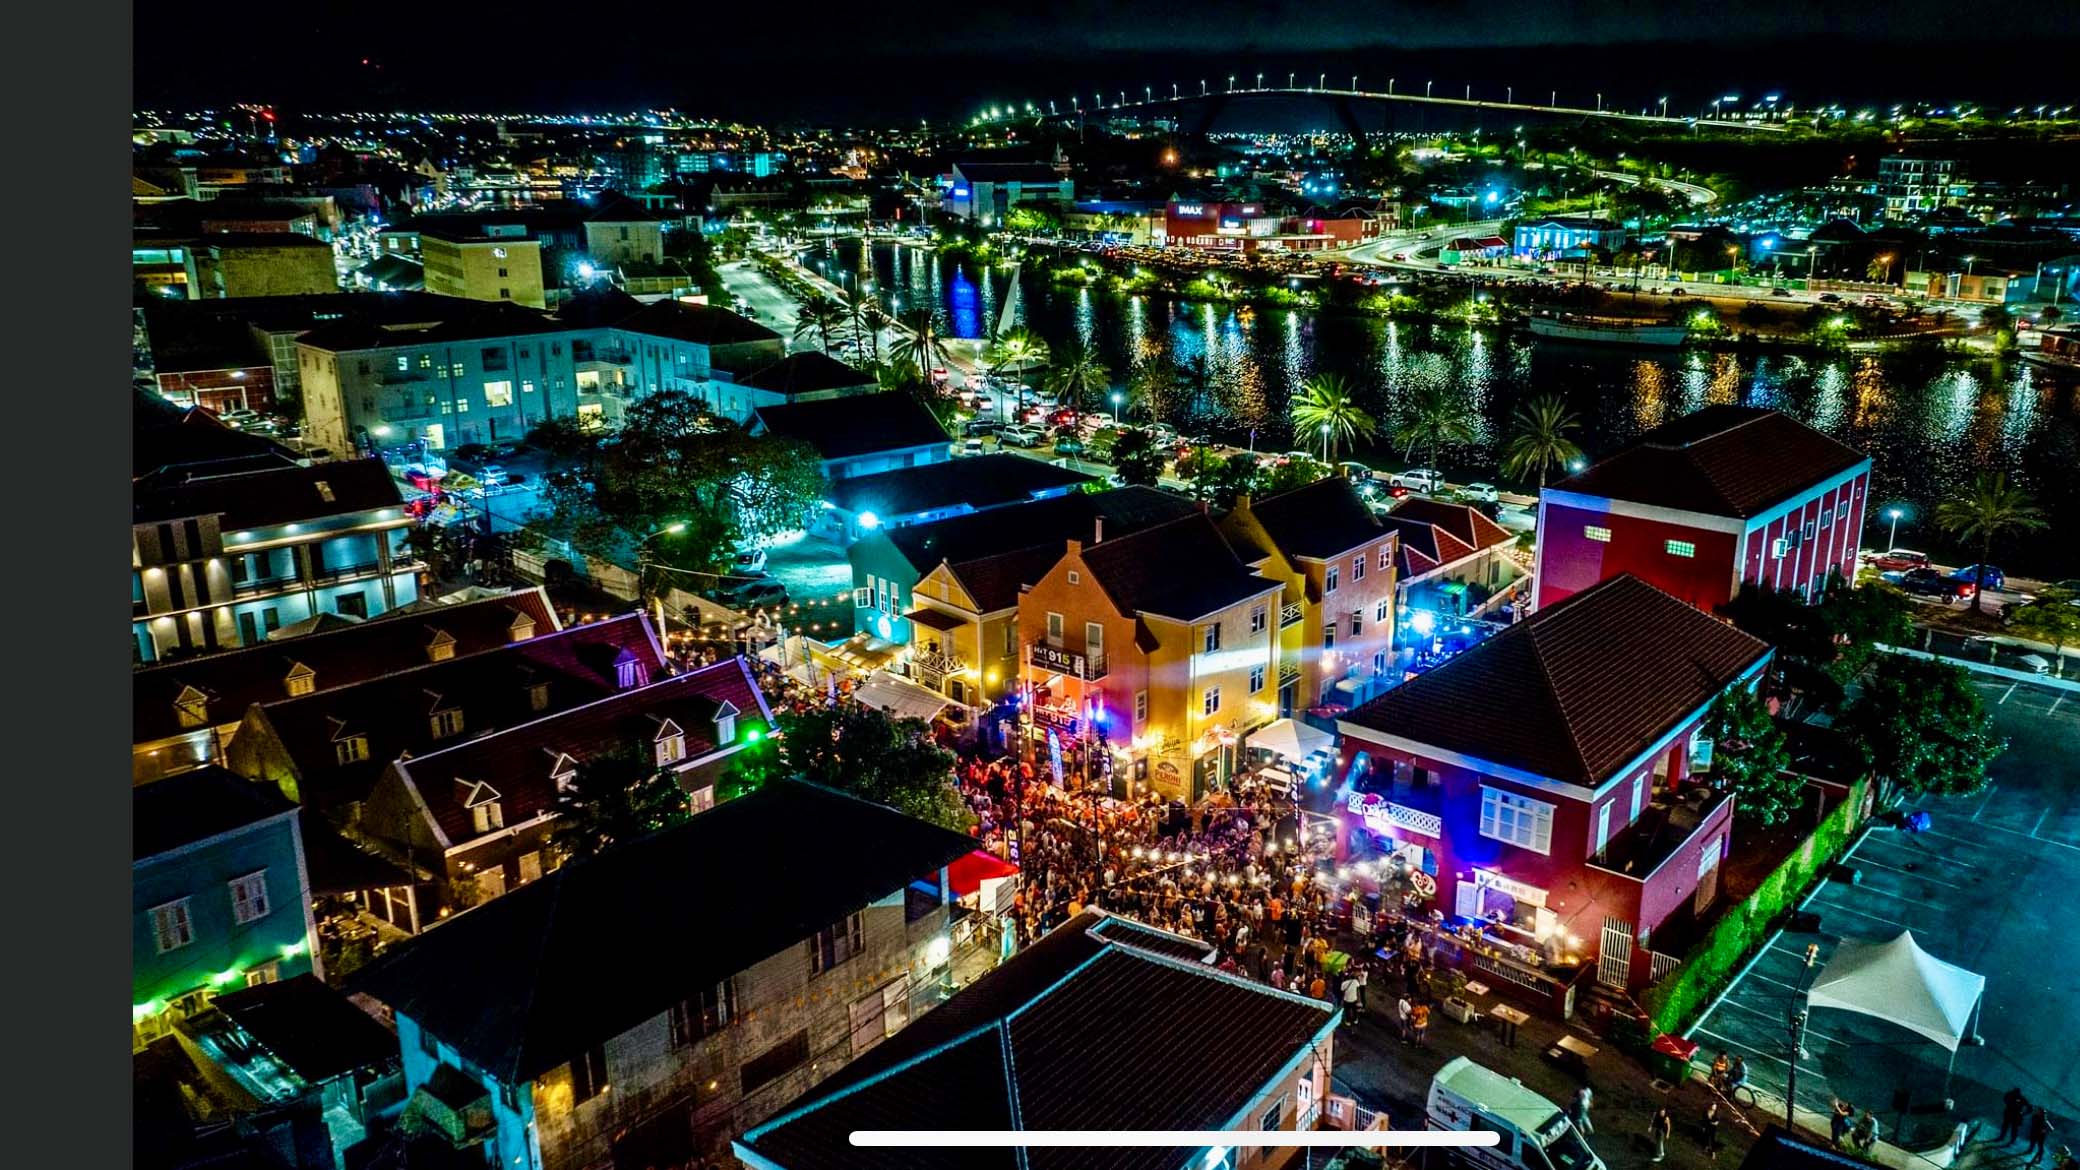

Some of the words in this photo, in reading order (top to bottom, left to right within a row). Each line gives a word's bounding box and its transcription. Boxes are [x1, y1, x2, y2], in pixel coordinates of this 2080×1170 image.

[1179, 205, 1203, 215] IMAX
[1048, 650, 1070, 666] 915
[1155, 769, 1181, 786] PERONI
